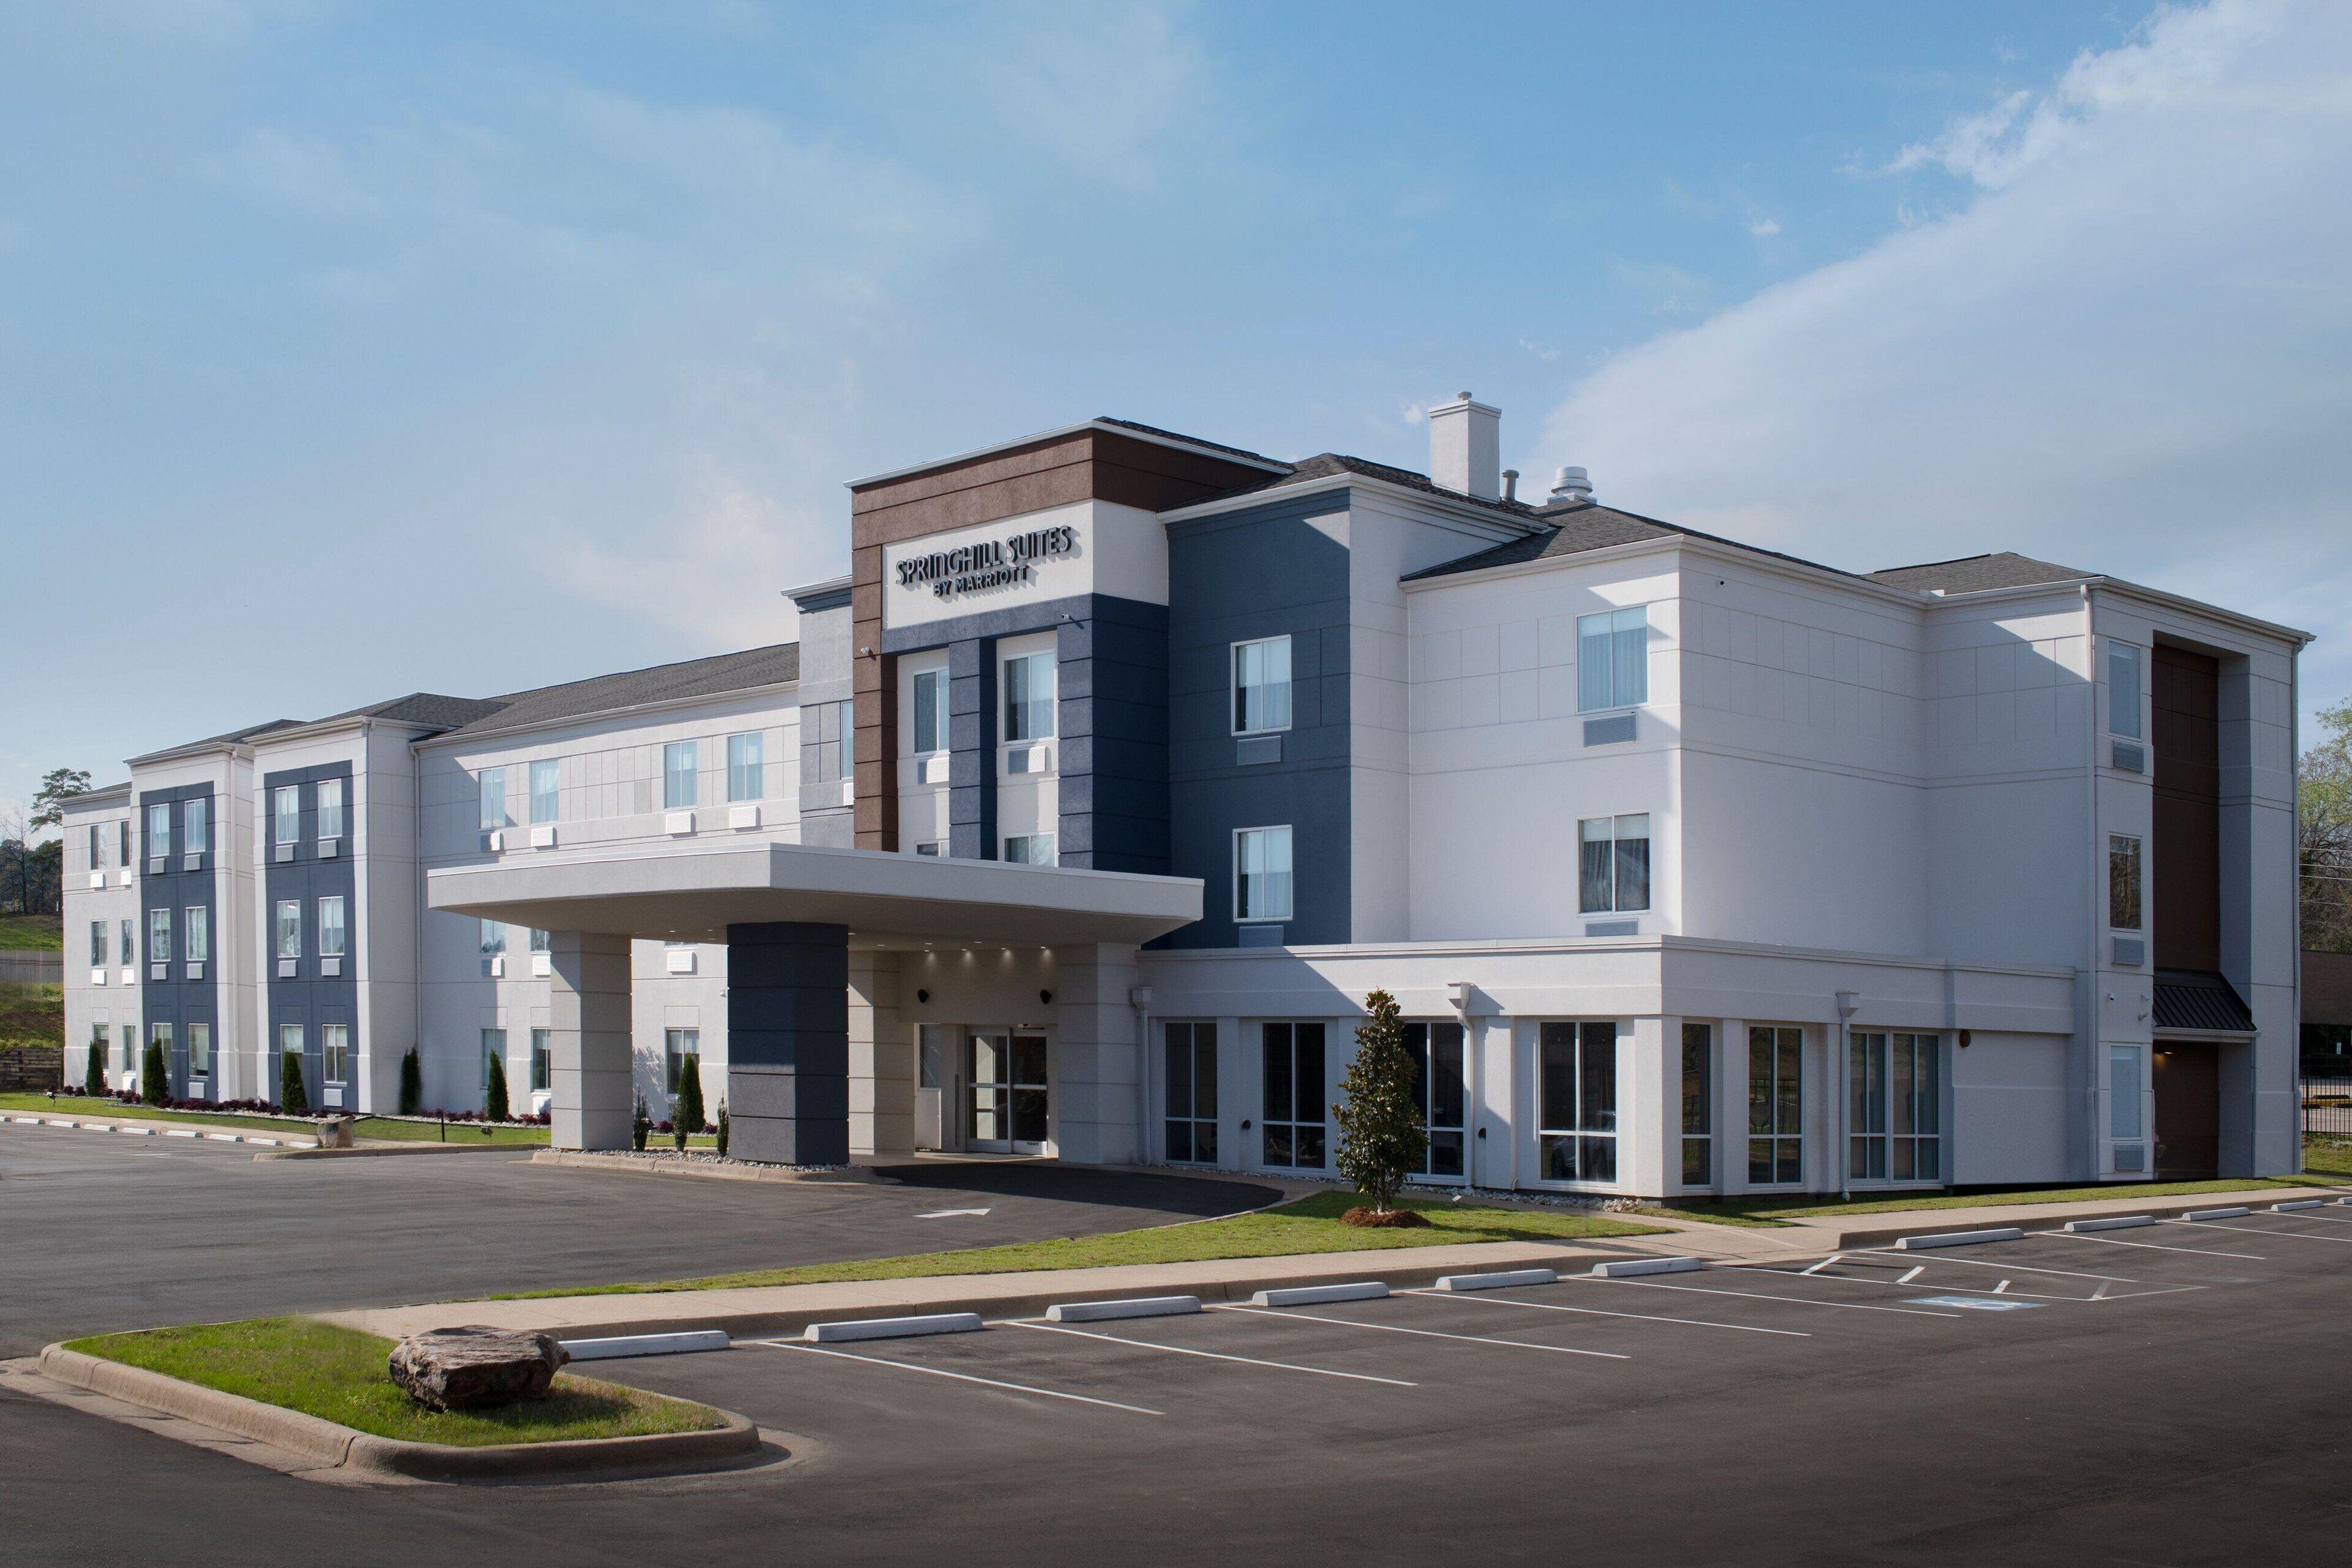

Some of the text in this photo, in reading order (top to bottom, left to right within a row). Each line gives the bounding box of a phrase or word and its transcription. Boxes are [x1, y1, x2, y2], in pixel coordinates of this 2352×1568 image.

[895, 525, 1072, 586] SPRINGHILL SUITES
[933, 564, 1030, 597] BY MARRIOTT
